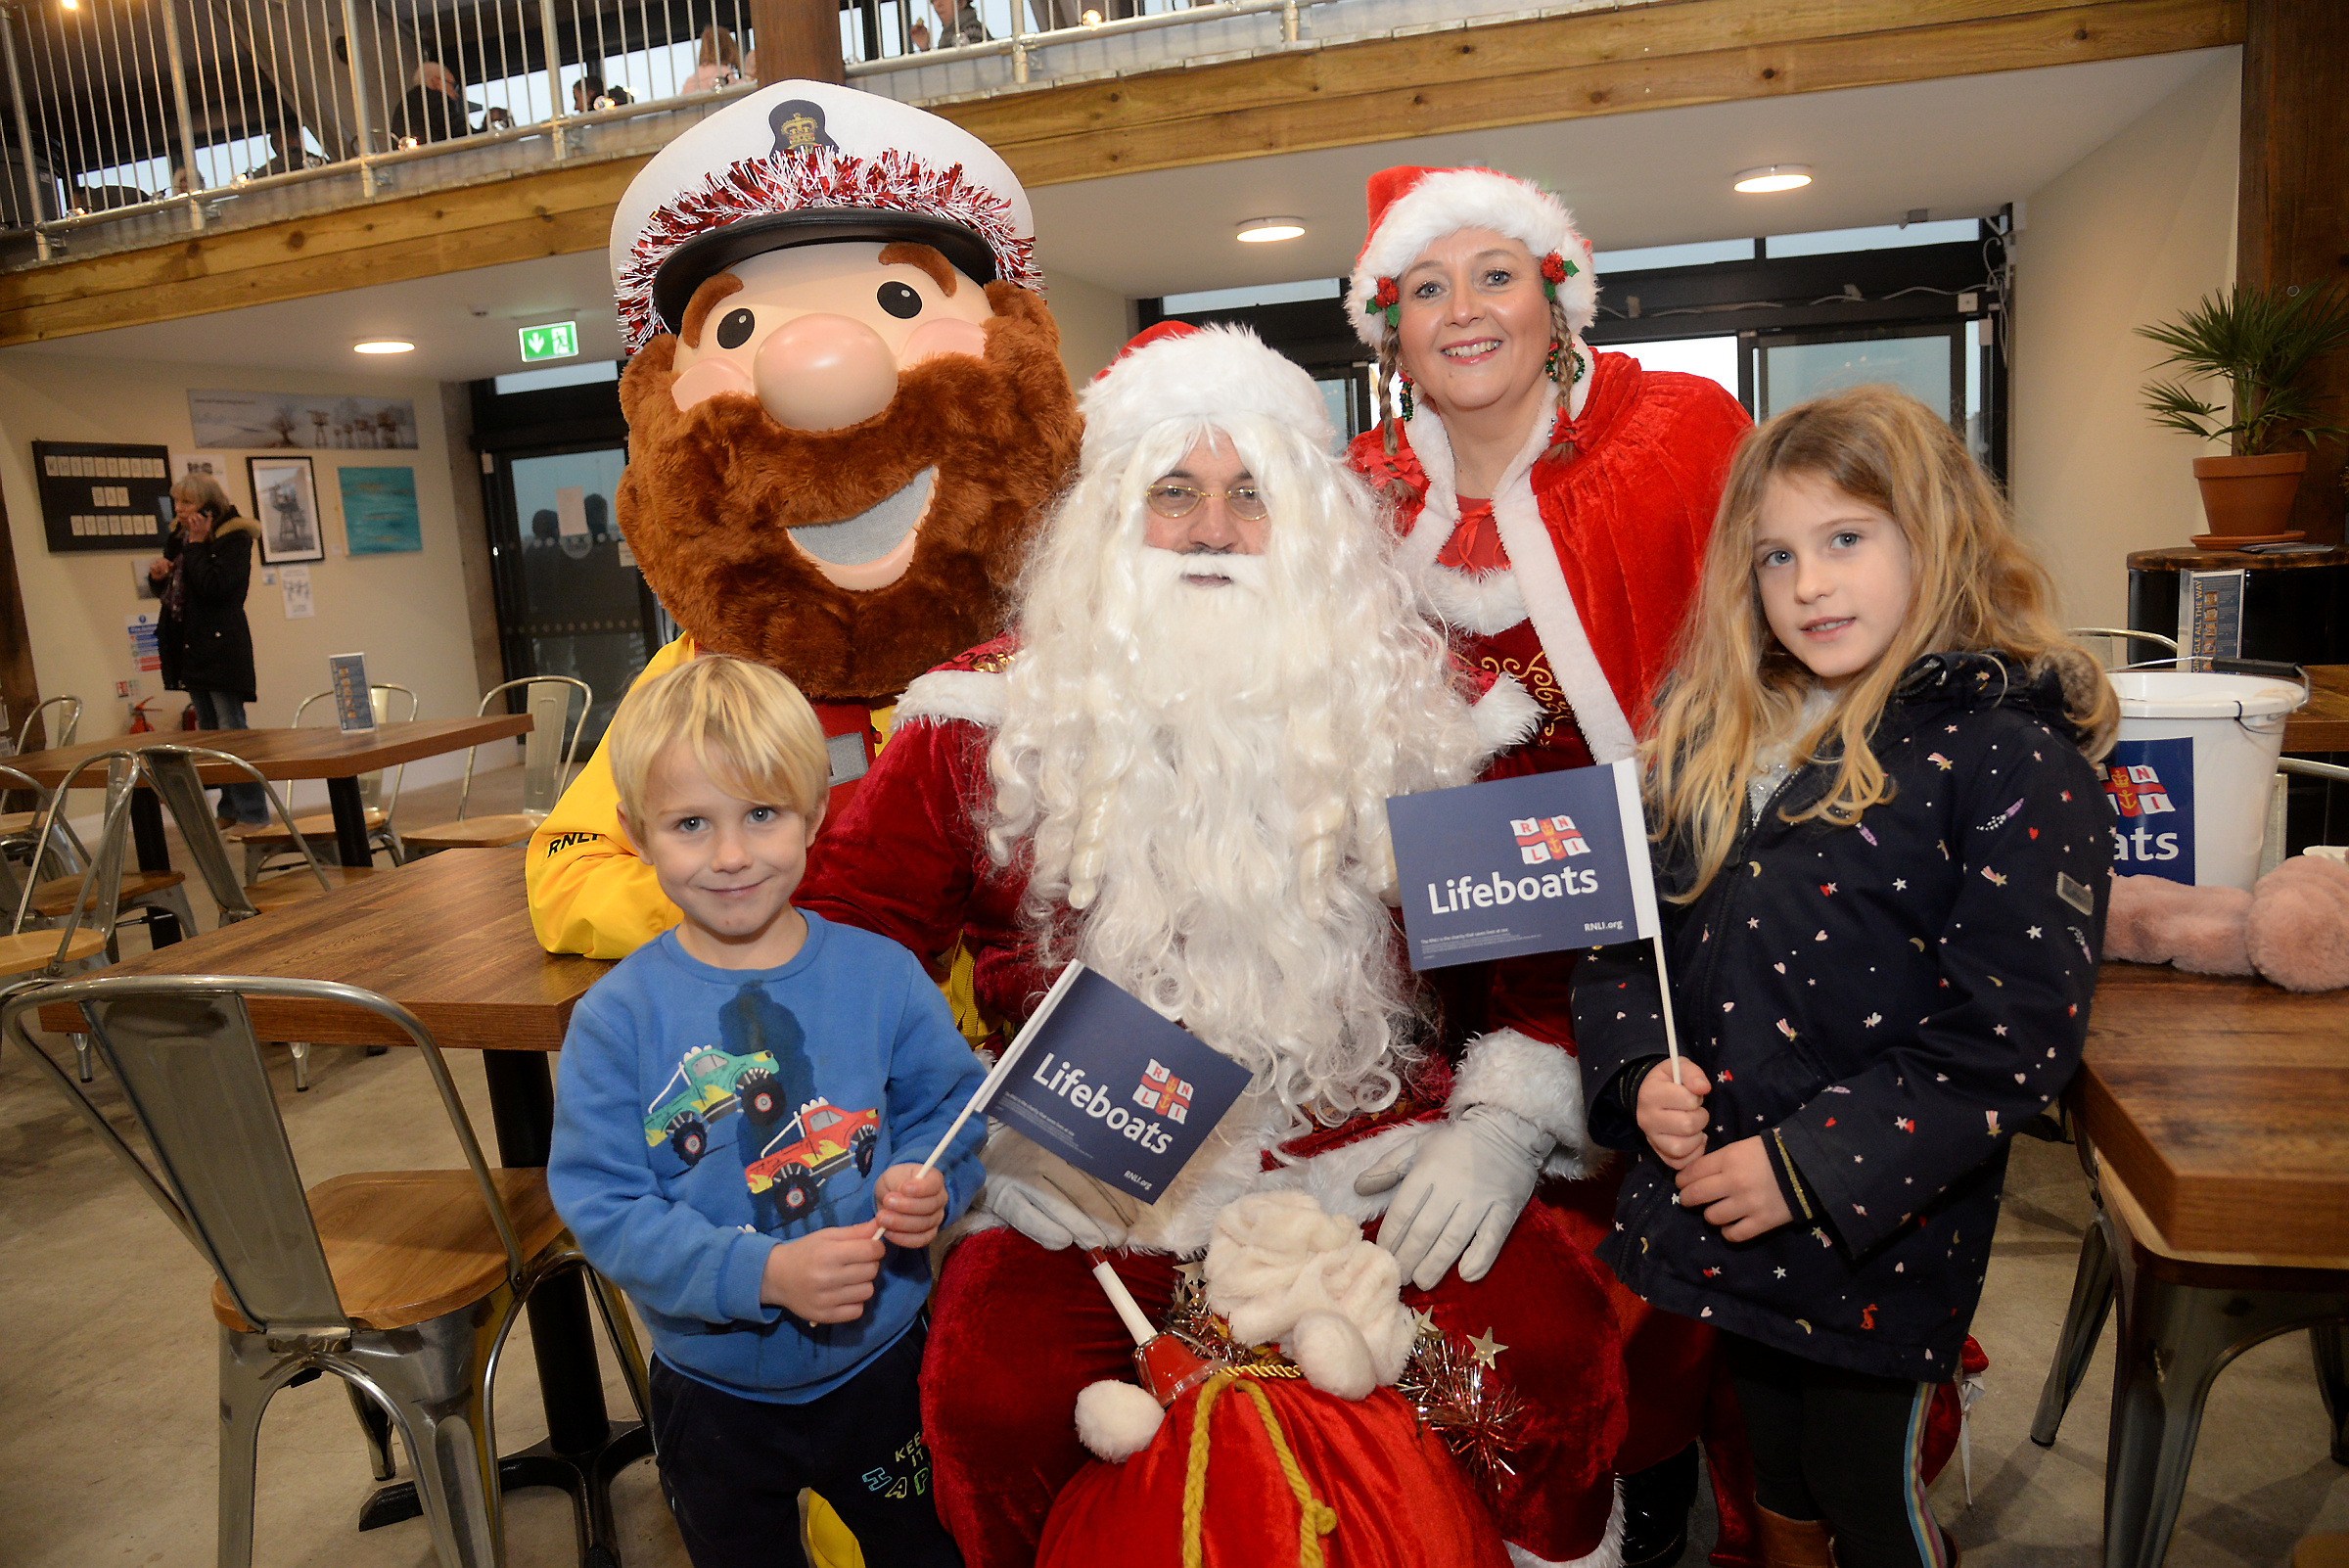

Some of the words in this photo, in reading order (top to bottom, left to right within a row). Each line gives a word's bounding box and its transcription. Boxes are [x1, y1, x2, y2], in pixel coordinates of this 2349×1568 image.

[47, 458, 163, 476] WHITSTABLE
[2194, 579, 2203, 599] WAY
[2135, 767, 2151, 780] N
[1520, 821, 1533, 834] R
[1557, 817, 1569, 829] N
[1531, 849, 1543, 861] L
[1427, 865, 1599, 914] Lifeboats
[1584, 920, 1624, 932] RNLI.org
[1152, 1066, 1163, 1079] R
[1180, 1084, 1190, 1096] N
[1033, 1052, 1174, 1154] Lifeboats
[1140, 1092, 1150, 1104] L
[1124, 1170, 1153, 1191] RNLI.org
[895, 1431, 921, 1462] KEE
[911, 1448, 924, 1467] IT
[861, 1467, 929, 1499] HAP
